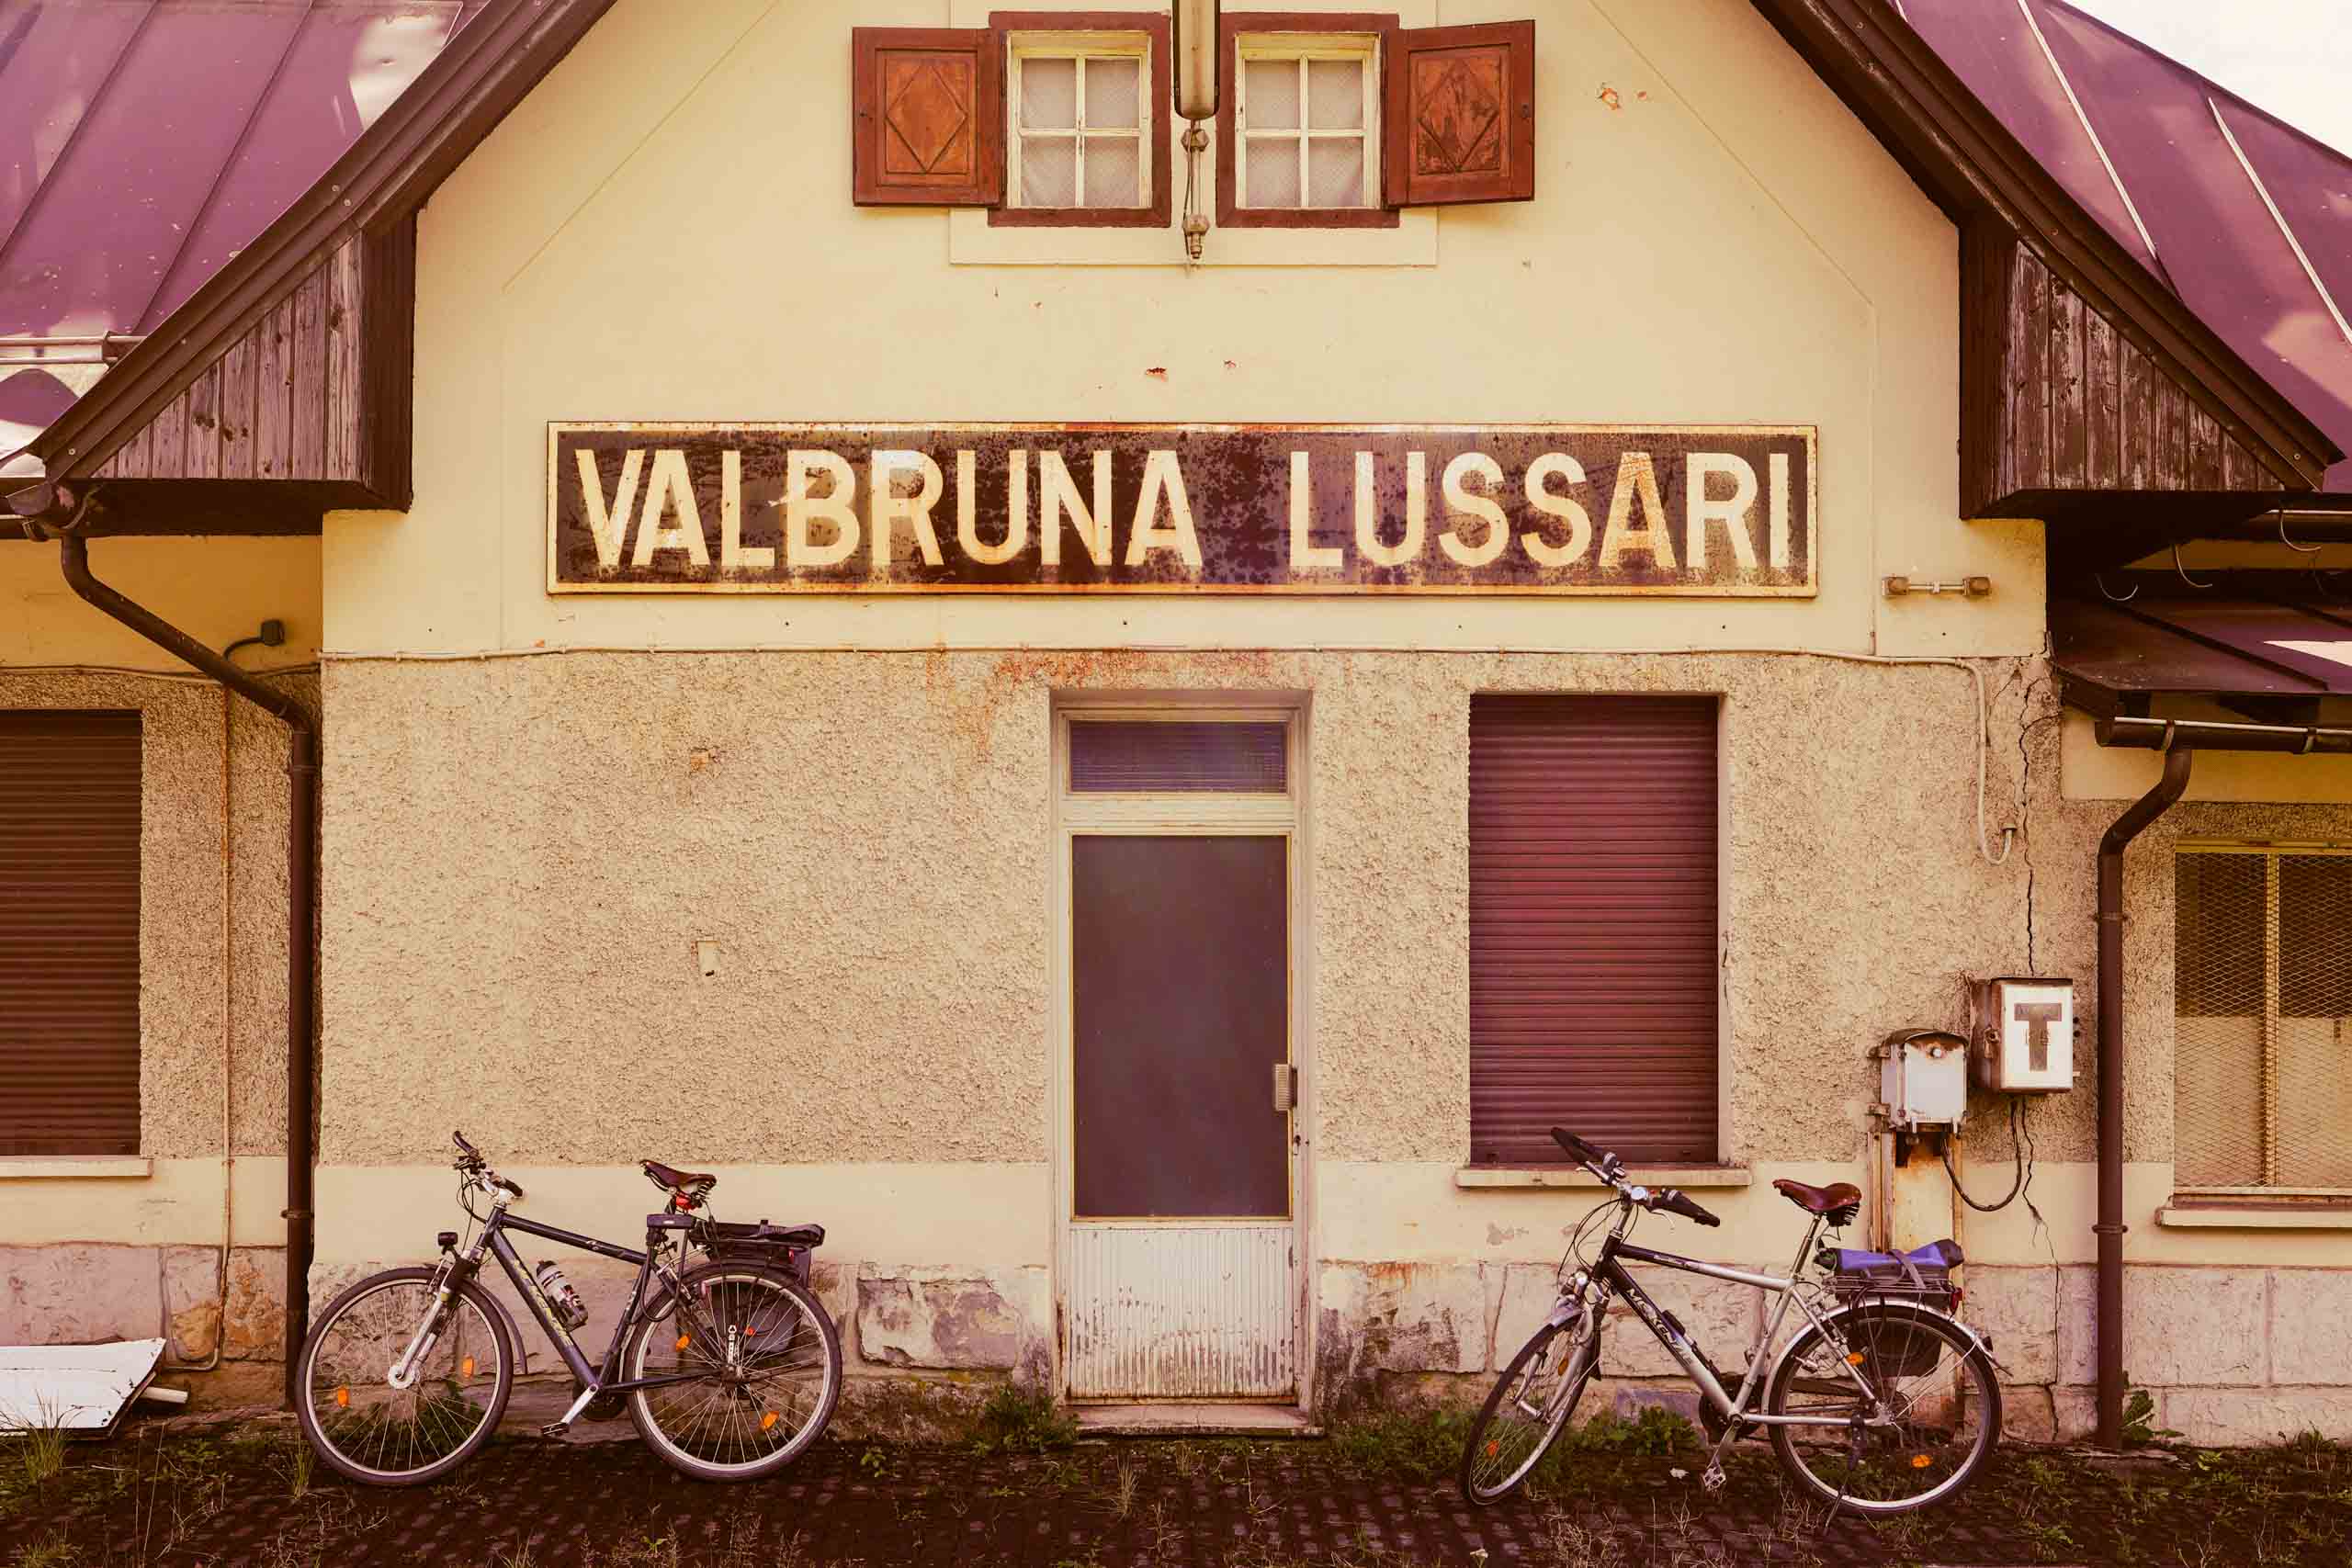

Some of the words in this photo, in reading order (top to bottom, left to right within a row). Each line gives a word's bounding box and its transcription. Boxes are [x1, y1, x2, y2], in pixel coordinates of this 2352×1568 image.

[575, 448, 1203, 568] VALBRUNA
[1290, 449, 1789, 570] LUSSARI
[2014, 1002, 2063, 1072] T
